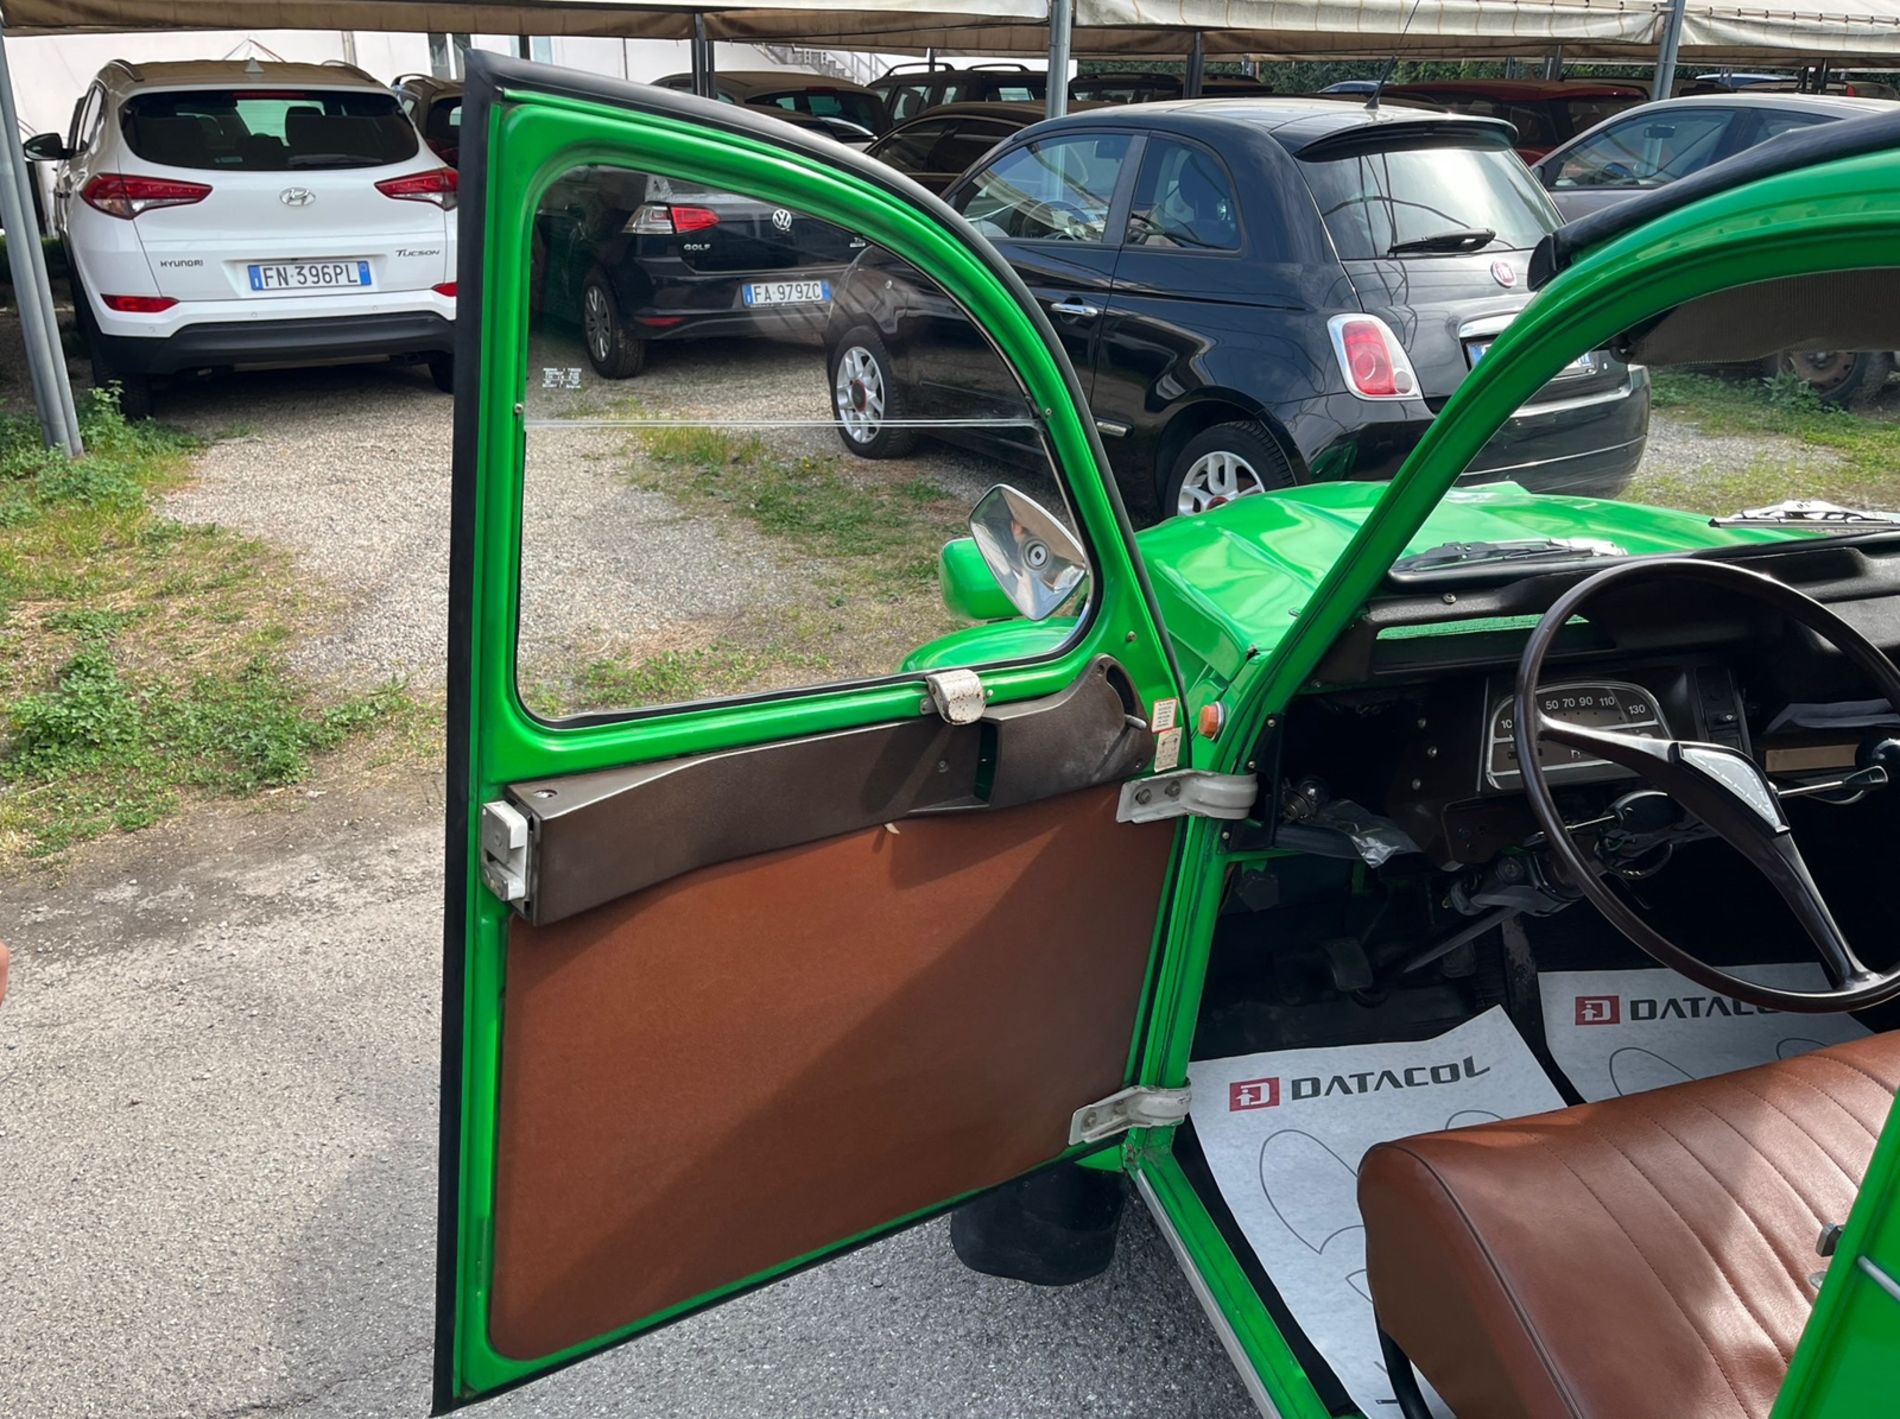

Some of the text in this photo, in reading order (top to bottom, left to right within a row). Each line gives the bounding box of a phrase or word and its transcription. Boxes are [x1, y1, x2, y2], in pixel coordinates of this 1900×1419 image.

[683, 243, 711, 251] GOLF
[1545, 696, 1615, 710] 50 70 90 110
[1628, 704, 1646, 714] 130
[1501, 719, 1512, 729] 10
[1630, 997, 1781, 1021] DATAC
[1291, 1055, 1491, 1101] DATACOL
